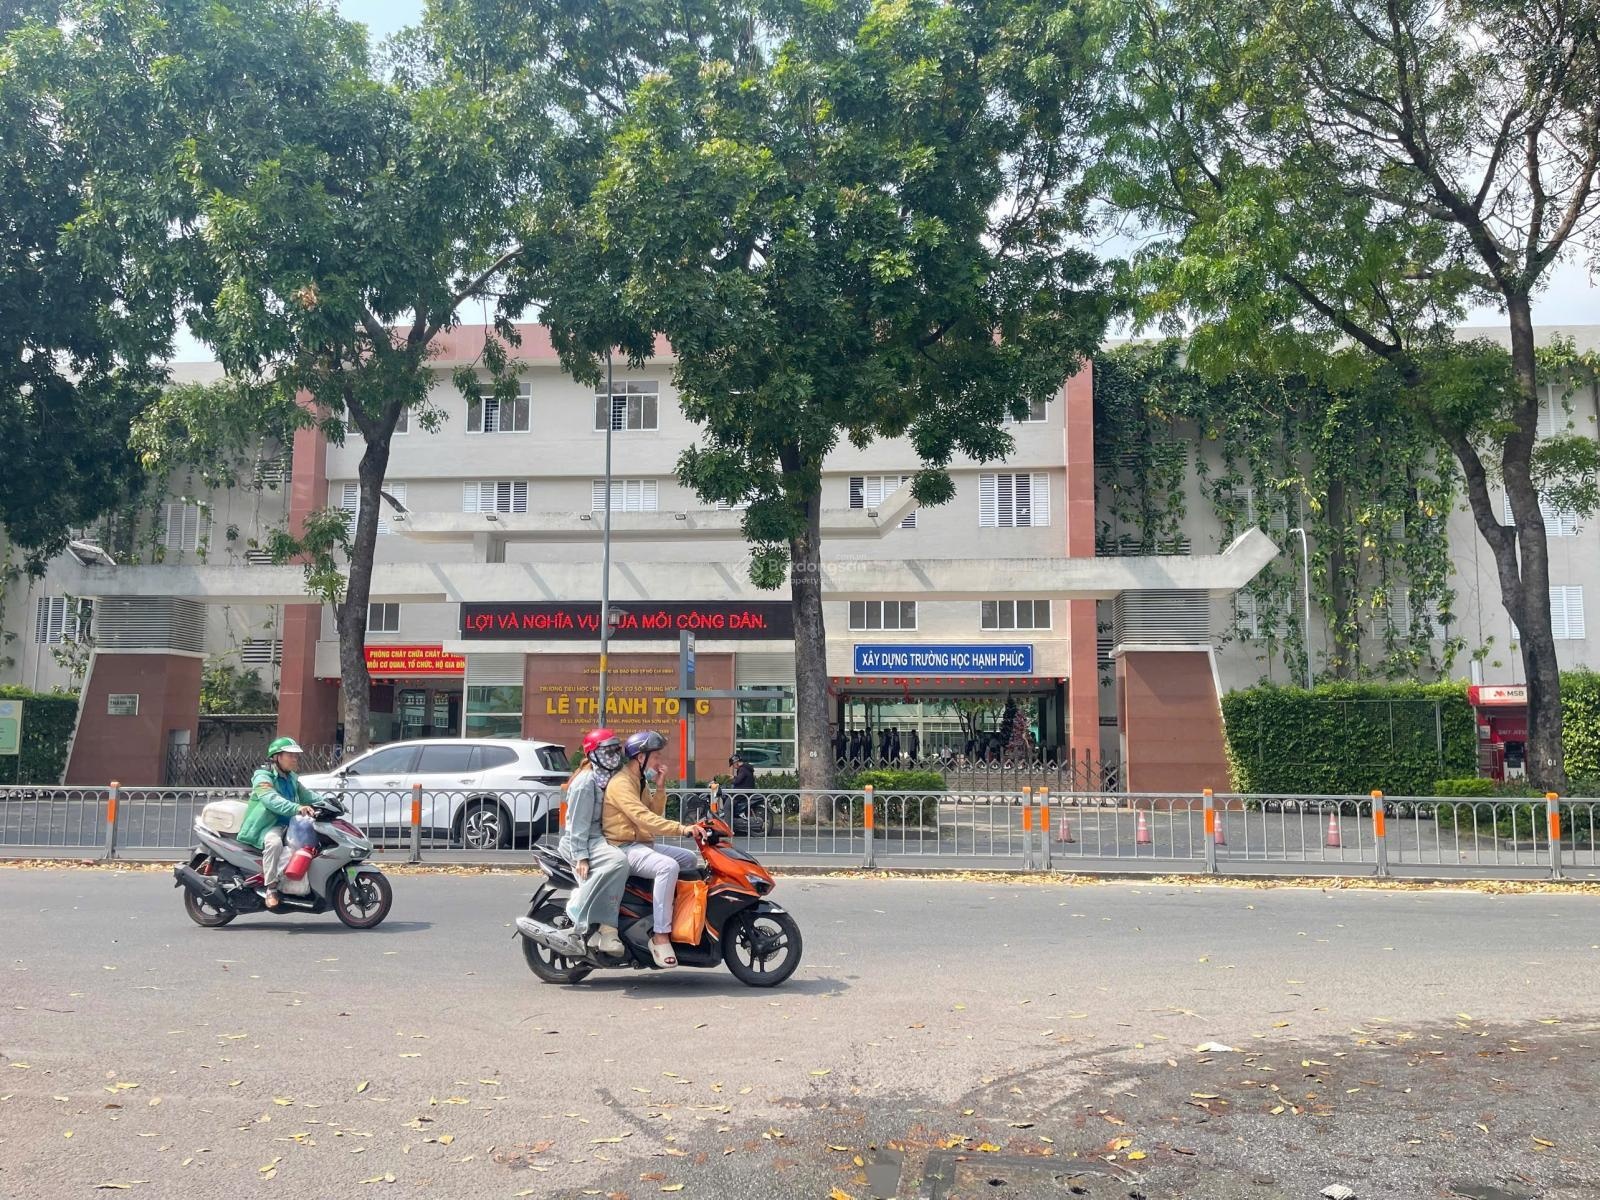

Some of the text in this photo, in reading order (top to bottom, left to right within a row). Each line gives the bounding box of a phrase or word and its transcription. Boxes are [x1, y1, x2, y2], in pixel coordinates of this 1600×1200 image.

[466, 612, 493, 631] LỢI
[498, 611, 519, 629] VÀ
[523, 611, 574, 629] NGHĨA
[578, 614, 599, 631] VỤ
[642, 610, 672, 629] MỖI
[676, 610, 725, 629] CÔNG
[729, 610, 768, 629] DÂN.
[862, 650, 1025, 669] XÂY DỰNG TRƯỜNG HỌC HẠNH PHÚC
[546, 692, 710, 715] LÊ THÁNH TOG
